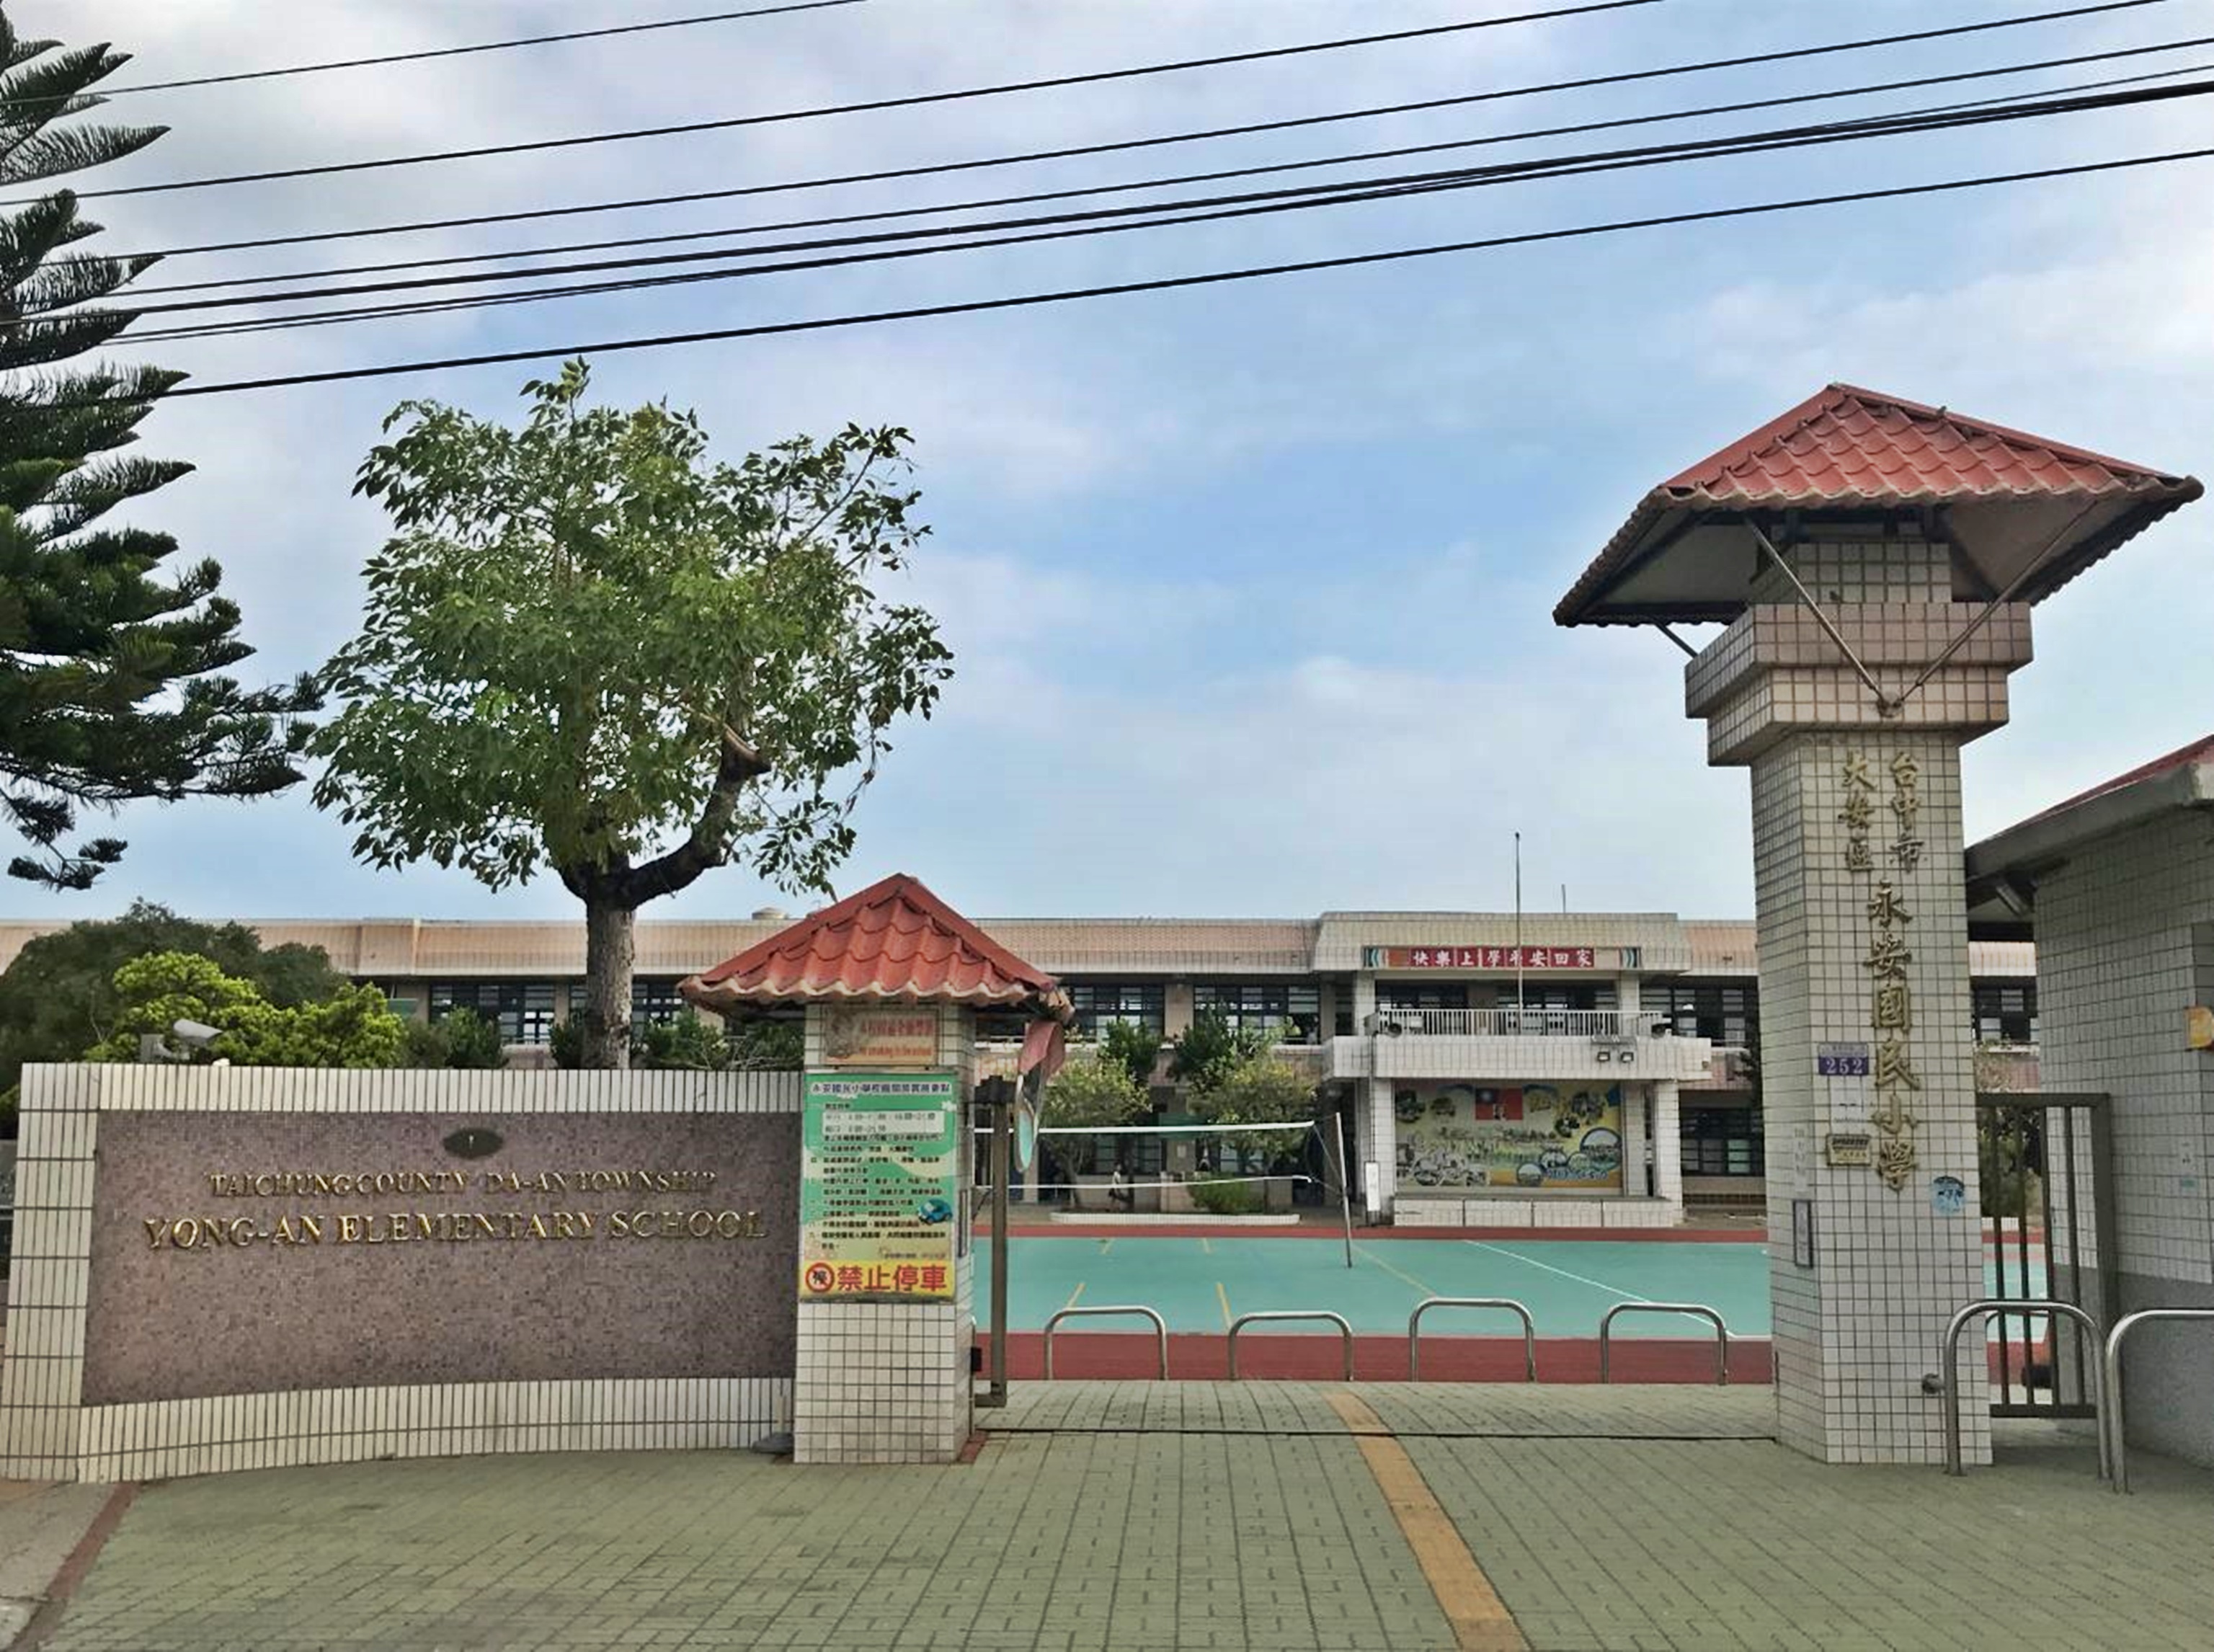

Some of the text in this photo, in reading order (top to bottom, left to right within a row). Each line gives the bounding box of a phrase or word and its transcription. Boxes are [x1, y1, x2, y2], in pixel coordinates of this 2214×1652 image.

[1838, 749, 1877, 873] 大安區
[1889, 750, 1926, 874] 台中市
[1413, 949, 1592, 967] 快樂上學平安回家
[1863, 879, 1921, 1191] 永安國民小學
[1826, 1057, 1863, 1075] 252
[209, 1169, 719, 1197] TAICHUNG COUNTY DA-AN TOWNSHIP
[145, 1210, 768, 1249] YONG-AN ELEMENTARY SCHOOL
[837, 1264, 947, 1292] 禁止停車
